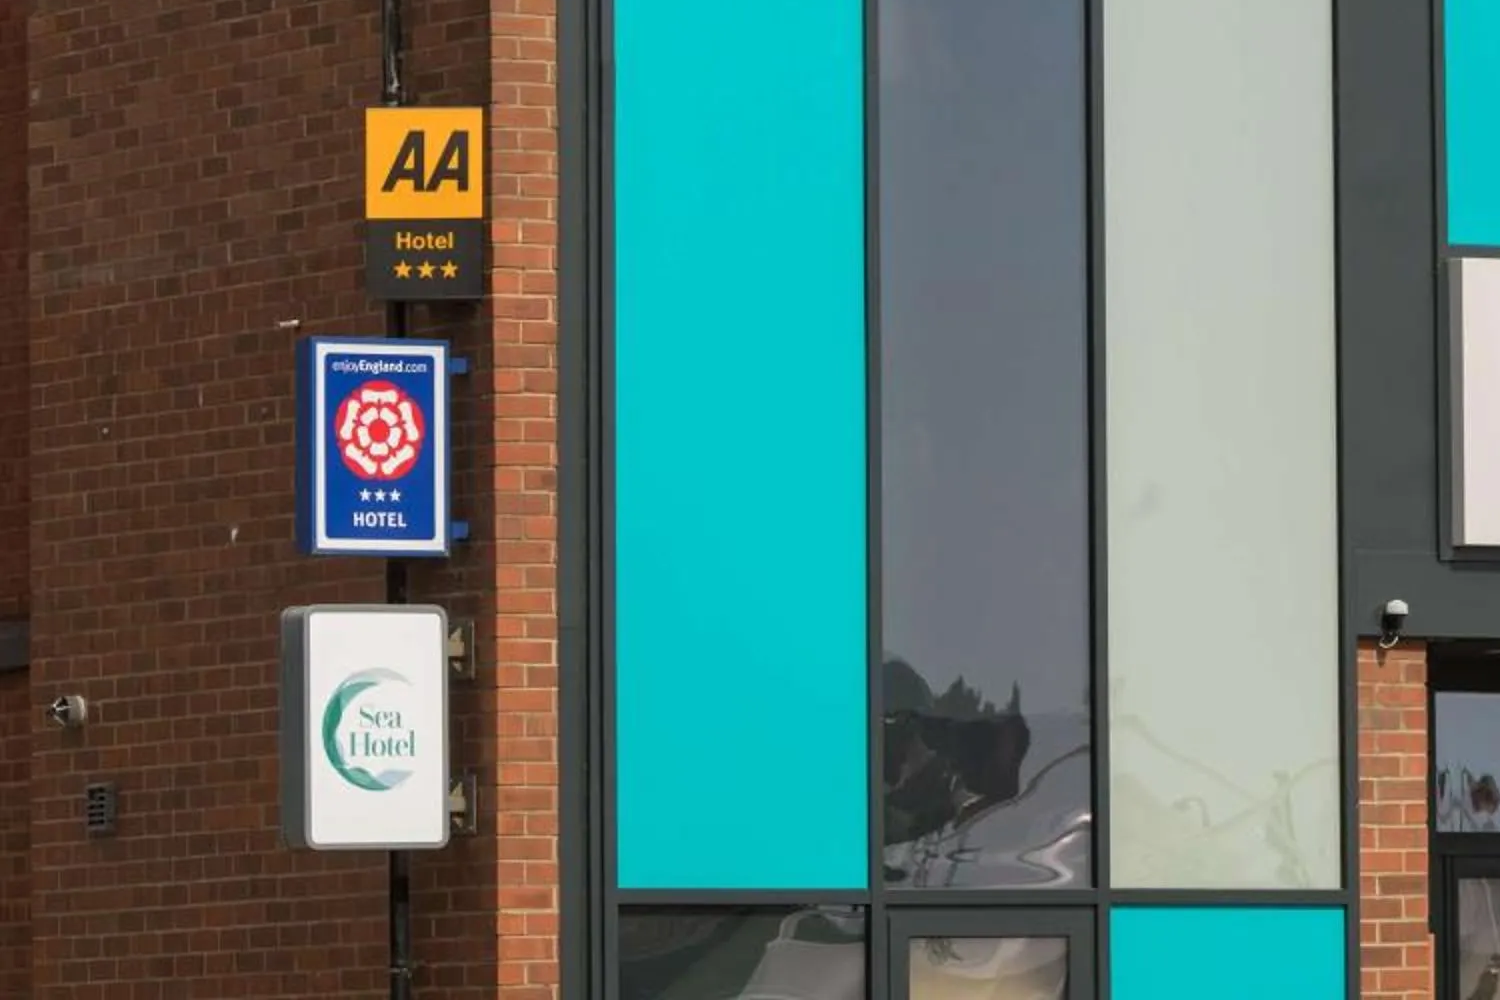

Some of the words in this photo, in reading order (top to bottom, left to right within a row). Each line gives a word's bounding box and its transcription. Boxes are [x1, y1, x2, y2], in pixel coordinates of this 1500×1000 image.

[381, 130, 469, 192] AA
[395, 232, 454, 249] Hotel
[332, 359, 427, 375] enjoyEngland.com
[353, 511, 407, 527] HOTEL
[359, 704, 402, 729] Sea
[350, 730, 415, 757] Hotel
